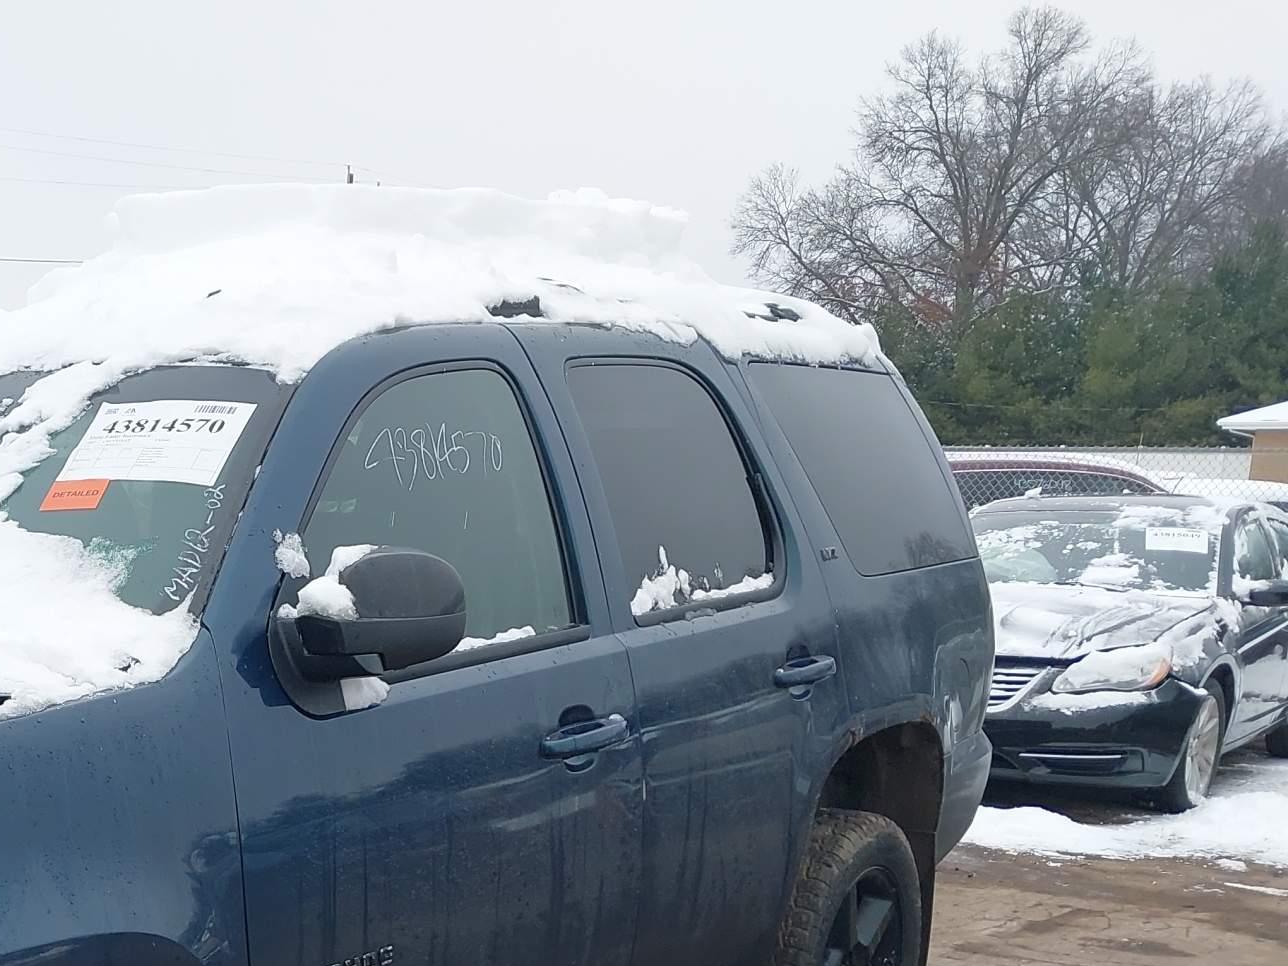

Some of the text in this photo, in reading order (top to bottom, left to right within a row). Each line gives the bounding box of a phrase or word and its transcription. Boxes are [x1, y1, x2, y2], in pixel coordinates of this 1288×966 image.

[103, 418, 226, 434] 43814570
[364, 422, 503, 491] 43814570
[52, 489, 100, 498] DETAILED
